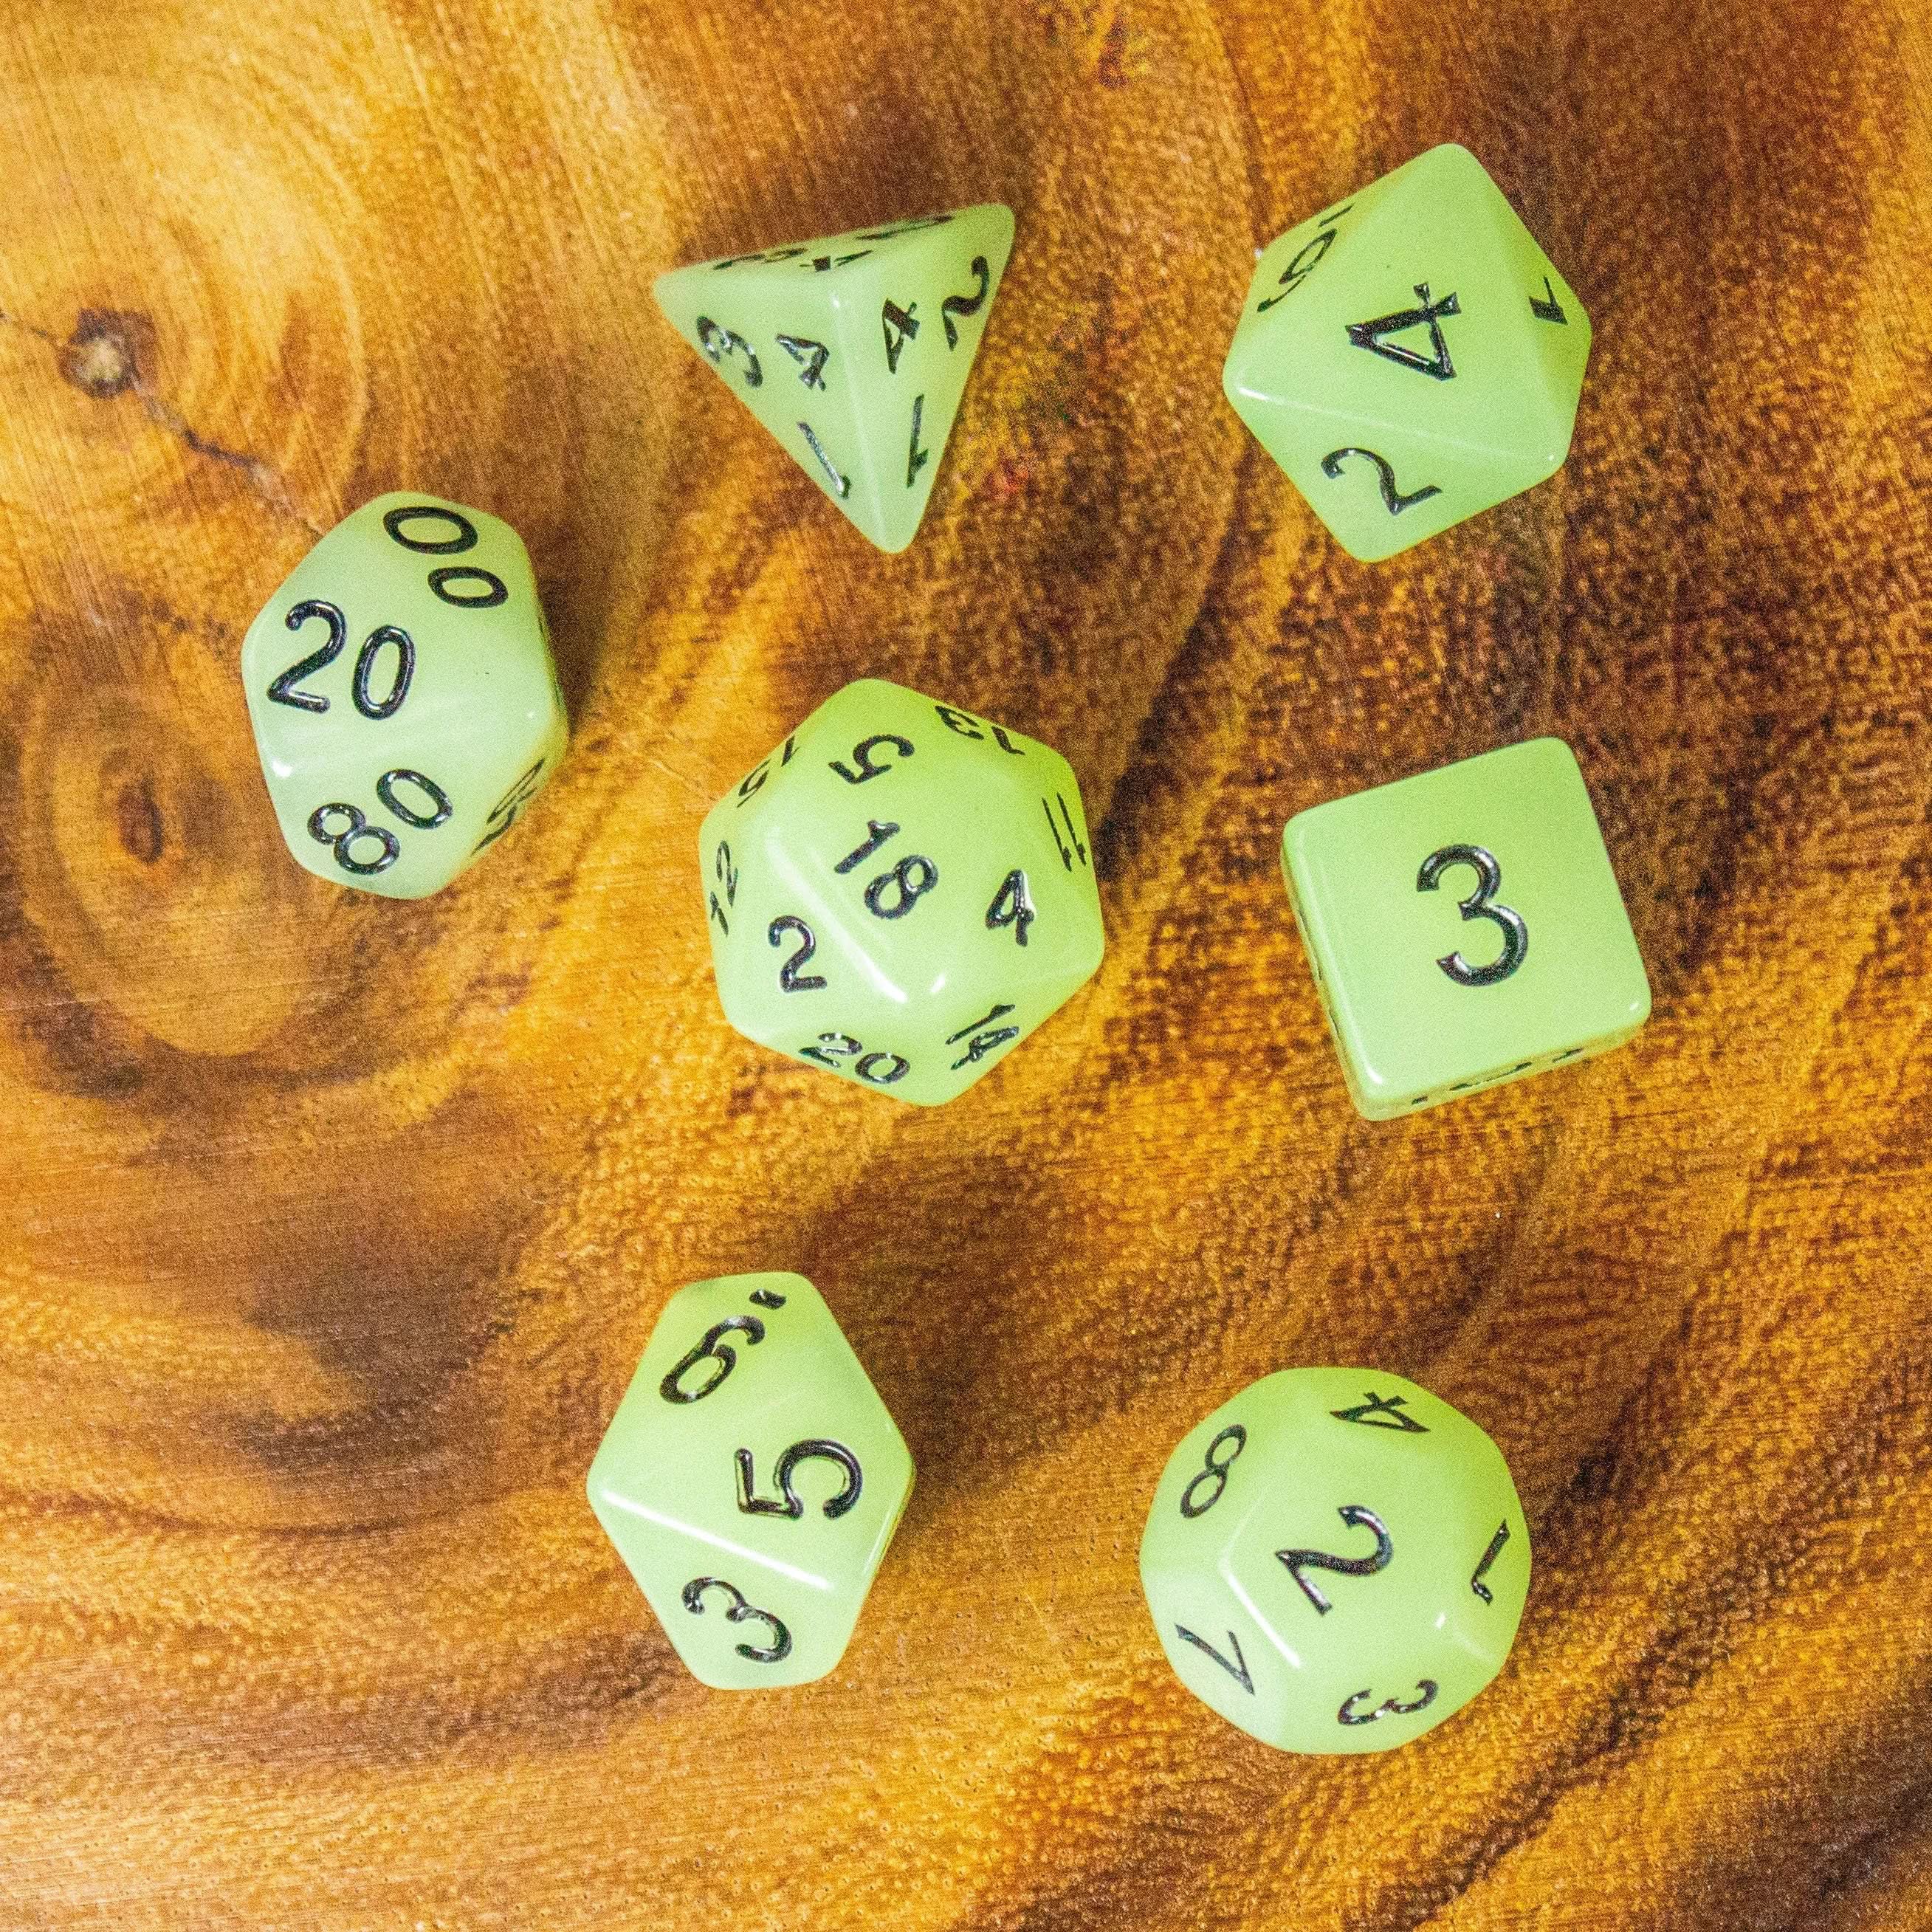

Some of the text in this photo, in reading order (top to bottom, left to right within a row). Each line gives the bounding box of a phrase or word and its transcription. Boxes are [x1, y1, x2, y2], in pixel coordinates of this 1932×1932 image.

[882, 298, 920, 374] 4
[941, 255, 989, 351] 2
[1344, 282, 1461, 381] 4
[696, 316, 763, 388] 3
[775, 334, 830, 391] 4
[797, 422, 850, 499] 1
[907, 394, 929, 488] 1
[1321, 447, 1442, 516] 2
[382, 506, 508, 608] 00
[267, 599, 415, 720] 20
[828, 734, 915, 785] 5
[935, 705, 1025, 756] 13
[307, 769, 453, 875] 80
[1041, 792, 1087, 872] 11
[709, 840, 738, 937] 12
[833, 820, 938, 920] 18
[985, 868, 1037, 947] 4
[768, 915, 828, 994] 2
[1416, 843, 1529, 987] 3
[800, 1031, 911, 1084] 20
[945, 1004, 1020, 1070] 14
[1329, 1392, 1431, 1433] 4
[734, 1438, 863, 1519] 5
[1180, 1424, 1247, 1519] 8
[1275, 1505, 1394, 1616] 2
[681, 1576, 792, 1663] 3
[1174, 1623, 1254, 1695] 7
[1337, 1679, 1438, 1726] 3
